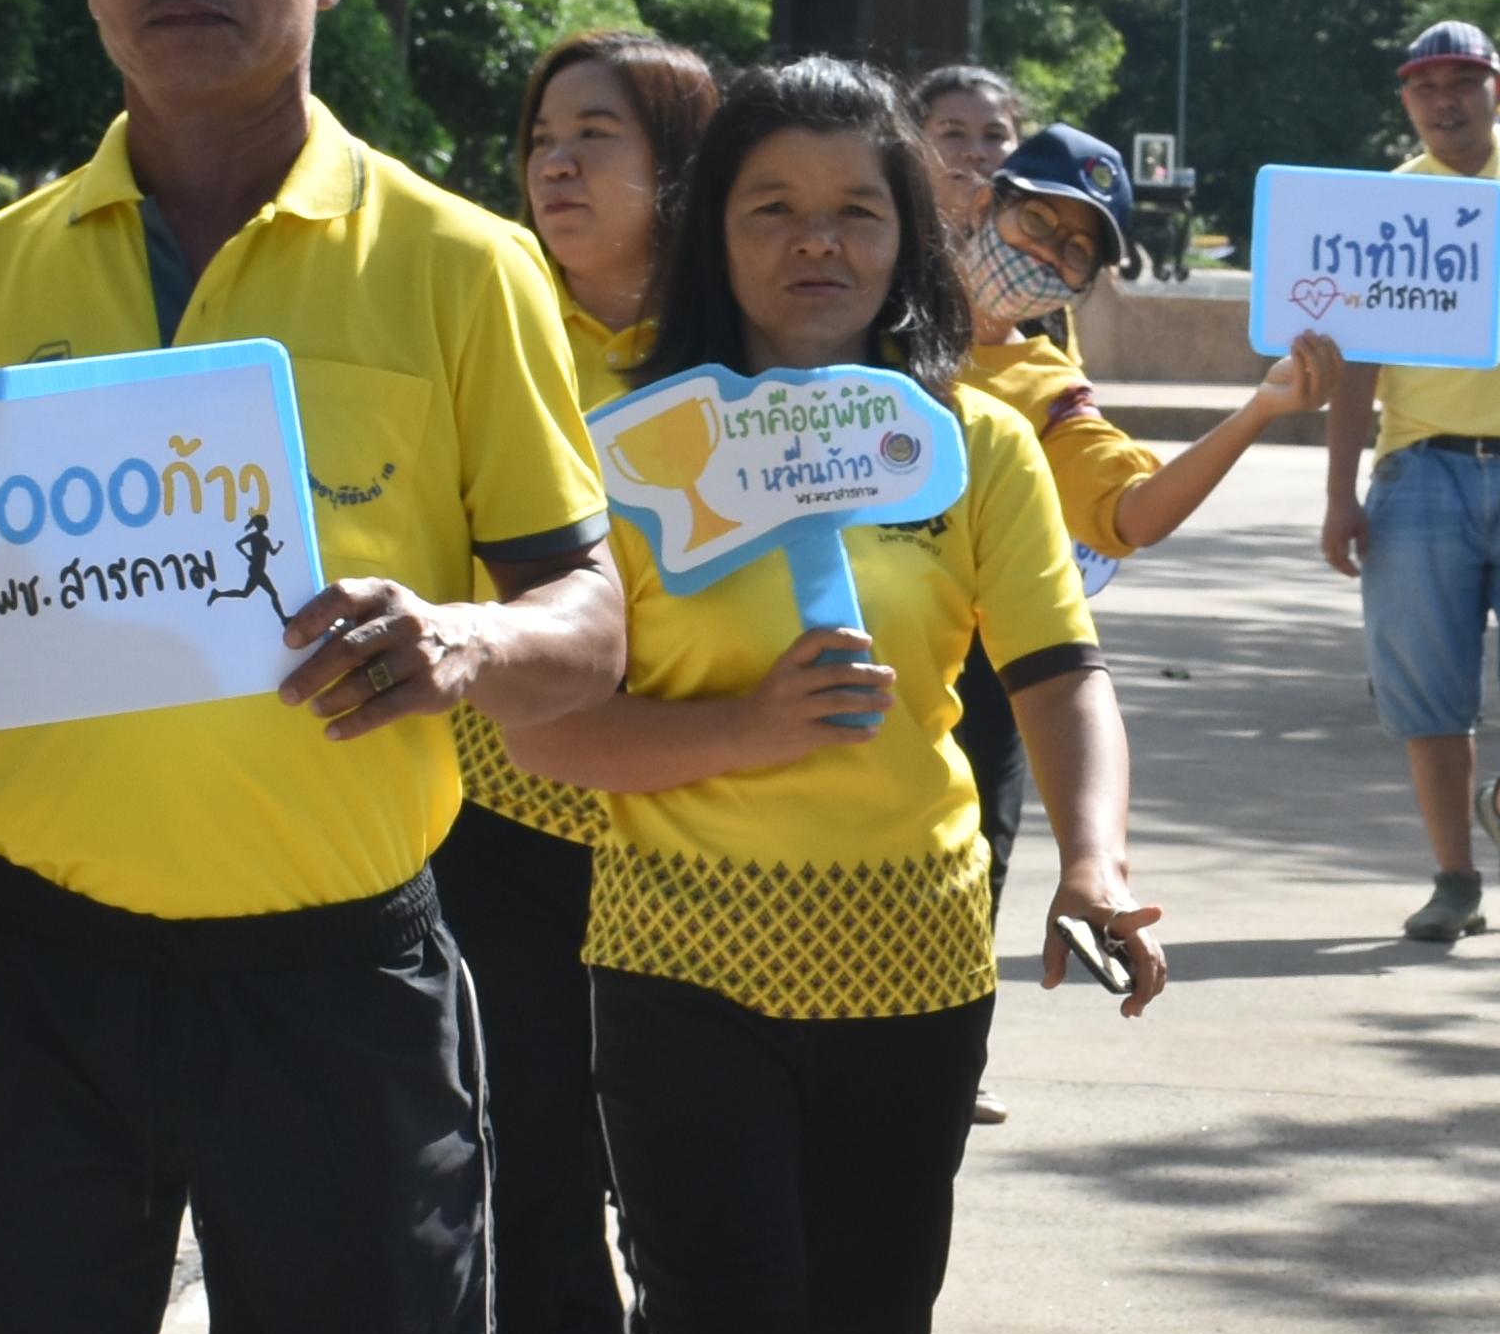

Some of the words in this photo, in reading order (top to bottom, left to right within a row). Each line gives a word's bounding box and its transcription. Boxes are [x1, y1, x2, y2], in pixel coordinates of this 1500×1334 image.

[1311, 207, 1481, 283] เราทำได้!
[724, 384, 898, 444] เราคือผู้พิชิต
[737, 467, 748, 491] 1
[762, 434, 873, 492] หมื่นก้าว
